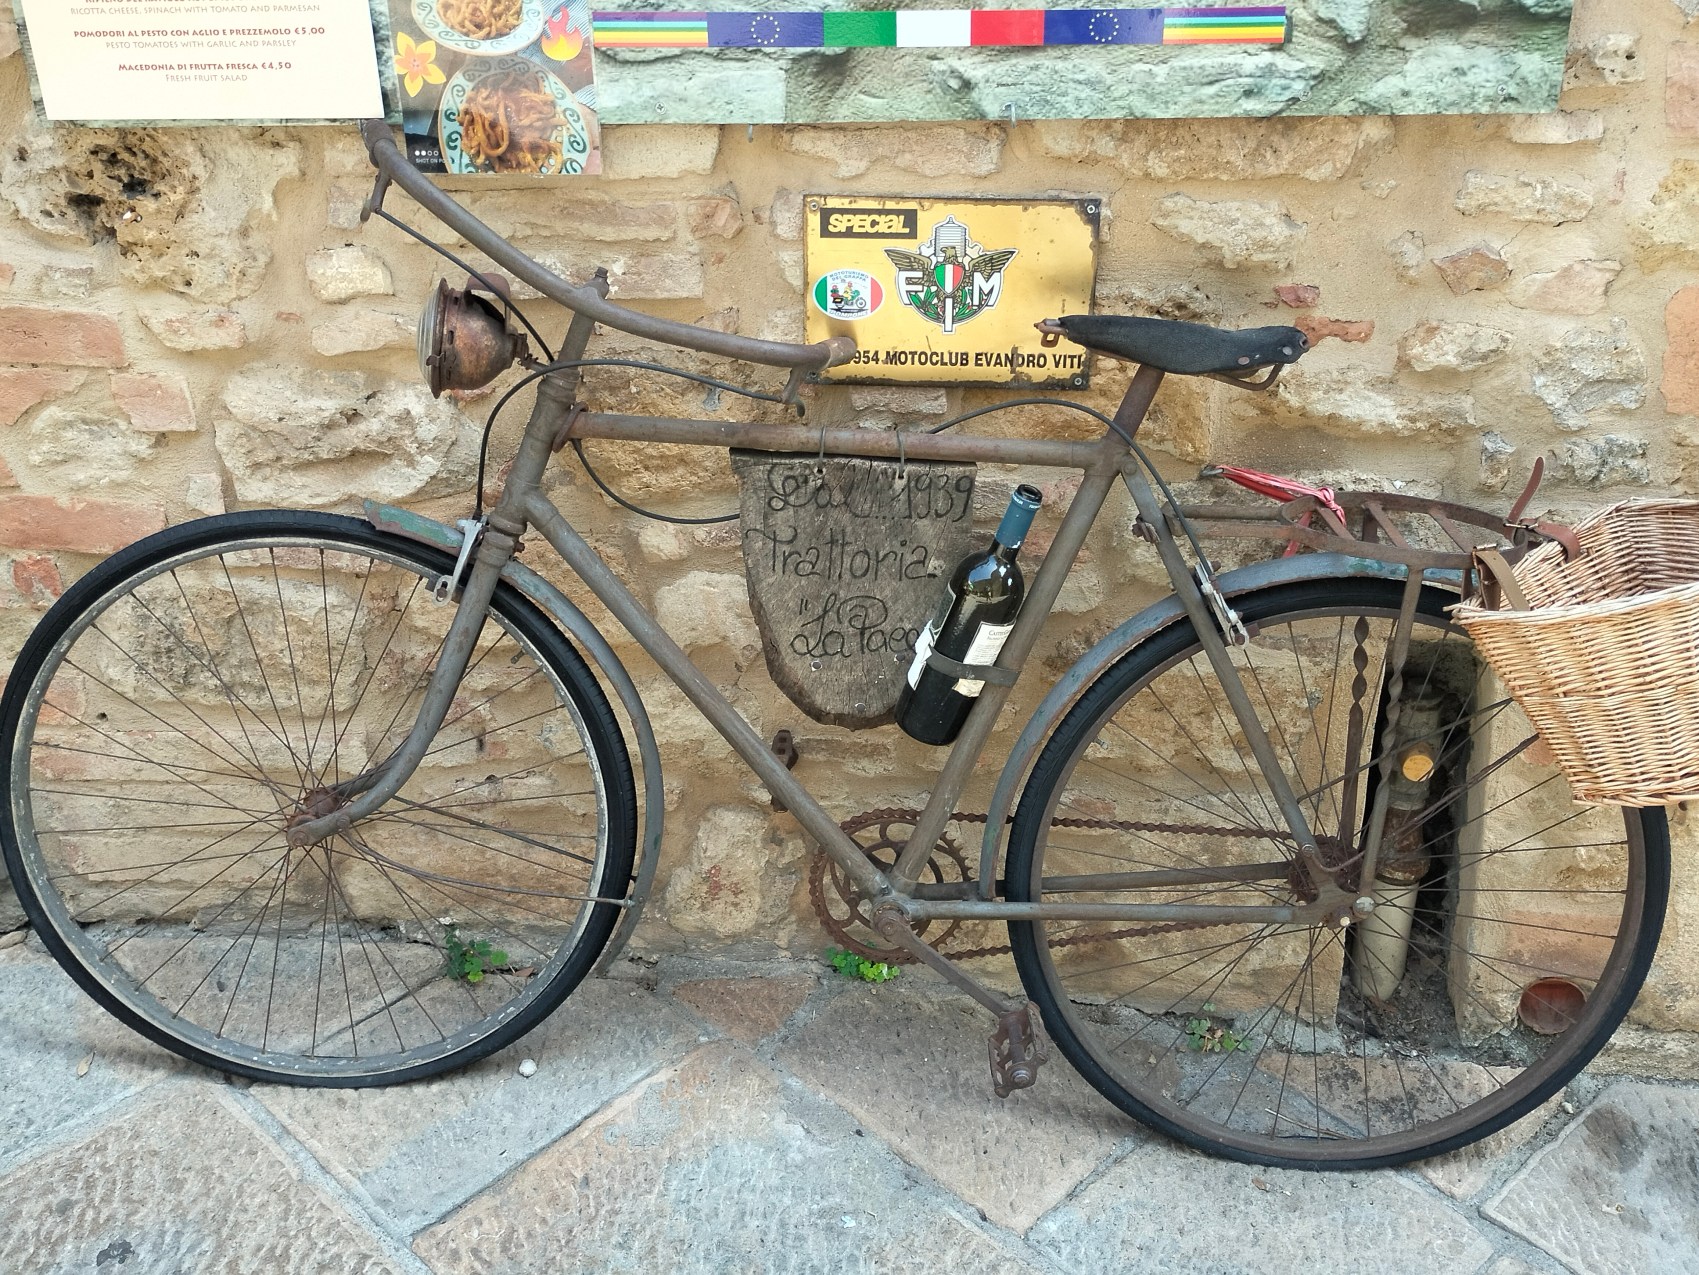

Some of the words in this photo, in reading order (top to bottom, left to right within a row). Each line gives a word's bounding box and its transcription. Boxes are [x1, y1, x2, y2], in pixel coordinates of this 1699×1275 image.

[70, 7, 106, 15] RICOTTA
[108, 7, 142, 15] CHEESE,
[144, 6, 182, 14] SPINACH
[184, 6, 208, 14] WITH
[210, 5, 248, 13] TOMATO
[250, 5, 270, 13] AND
[273, 4, 320, 12] PARMESAN
[73, 30, 125, 38] POMODORI
[141, 29, 168, 37] PESTO
[222, 28, 228, 36] E
[229, 28, 291, 36] PREZZEMOLO
[105, 41, 131, 49] PESTO
[132, 41, 178, 49] TOMATOES
[206, 40, 238, 48] GARLIC
[239, 40, 259, 48] AND
[261, 39, 297, 47] PARSLEY
[118, 63, 175, 71] MACEDONIA
[177, 63, 187, 71] DI
[189, 63, 224, 71] FRUTTA
[165, 74, 191, 82] FRESH
[194, 74, 218, 82] FRUIT
[220, 74, 248, 82] SALAD
[848, 349, 880, 365] 954
[884, 350, 969, 367] MOTOCLUB
[974, 352, 1047, 369] EVANDRO
[1052, 353, 1083, 369] VITI
[889, 471, 976, 523] 1939
[745, 525, 938, 582] Trattoria
